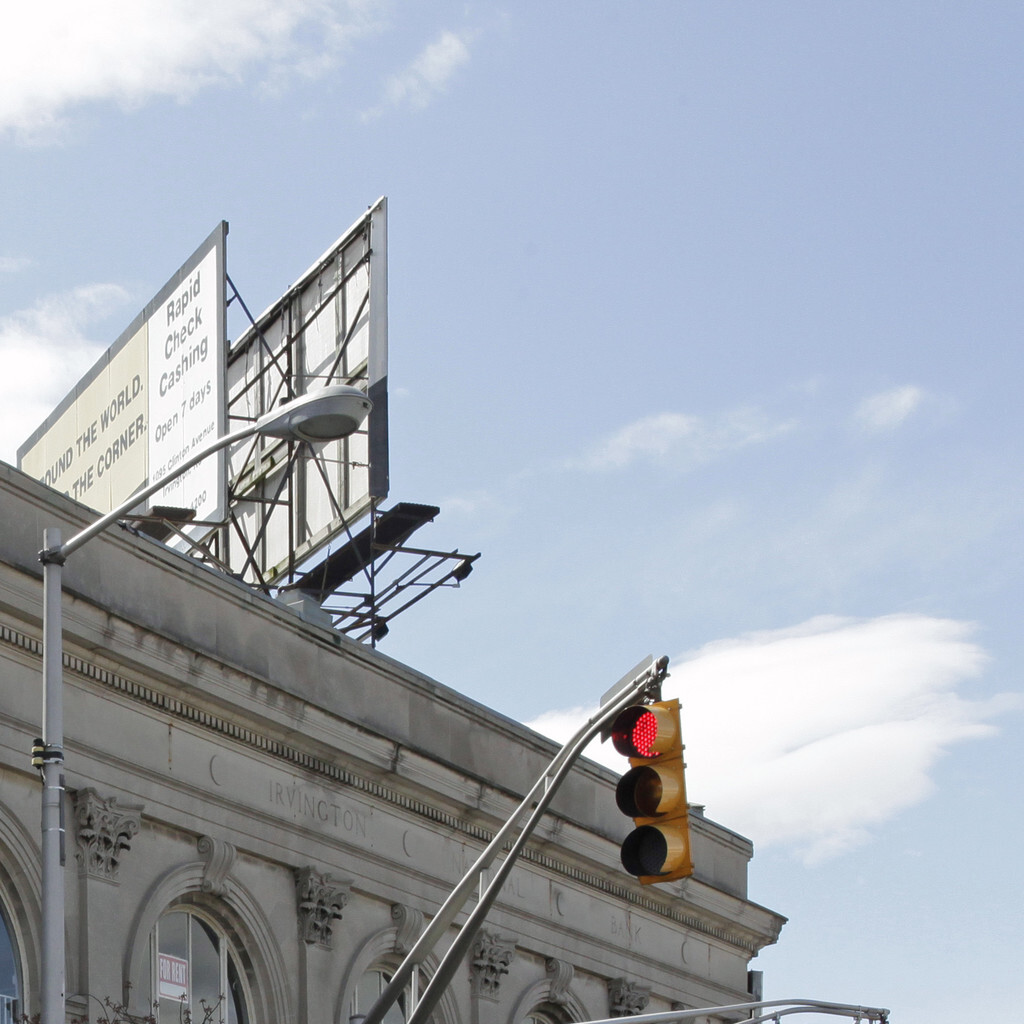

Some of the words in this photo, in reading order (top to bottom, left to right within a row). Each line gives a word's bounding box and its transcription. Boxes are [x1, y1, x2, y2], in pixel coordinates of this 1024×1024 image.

[166, 270, 201, 327] Rapid
[164, 306, 203, 360] Check
[159, 335, 208, 398] Cashing
[76, 420, 97, 457] THE
[100, 374, 143, 433] WORLD.
[155, 412, 178, 443] Open
[181, 399, 187, 418] 7
[189, 379, 211, 411] days
[72, 465, 94, 498] THE
[97, 413, 146, 478] CORNER.
[167, 445, 190, 471] Clinton
[191, 421, 215, 449] Avenue
[269, 780, 367, 838] IRVINGTON
[160, 958, 171, 980] FOR
[171, 961, 186, 985] RENT
